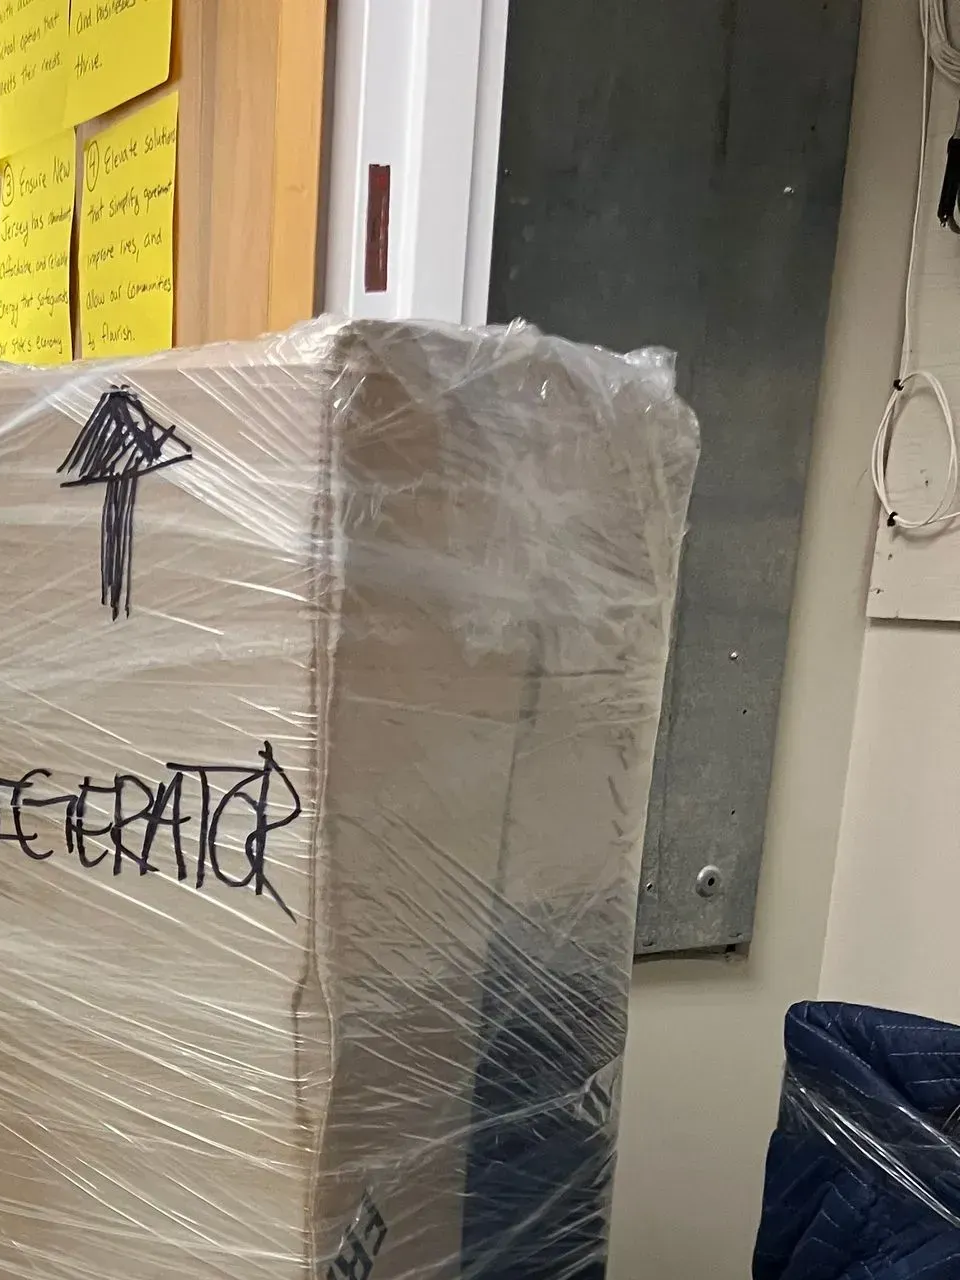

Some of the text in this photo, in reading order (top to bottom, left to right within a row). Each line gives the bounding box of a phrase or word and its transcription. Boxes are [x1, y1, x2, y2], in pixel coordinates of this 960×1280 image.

[19, 165, 47, 197] Ensure
[52, 155, 71, 185] New
[1, 215, 29, 247] Jersey
[31, 213, 44, 231] has
[143, 226, 163, 248] and
[109, 284, 122, 302] our
